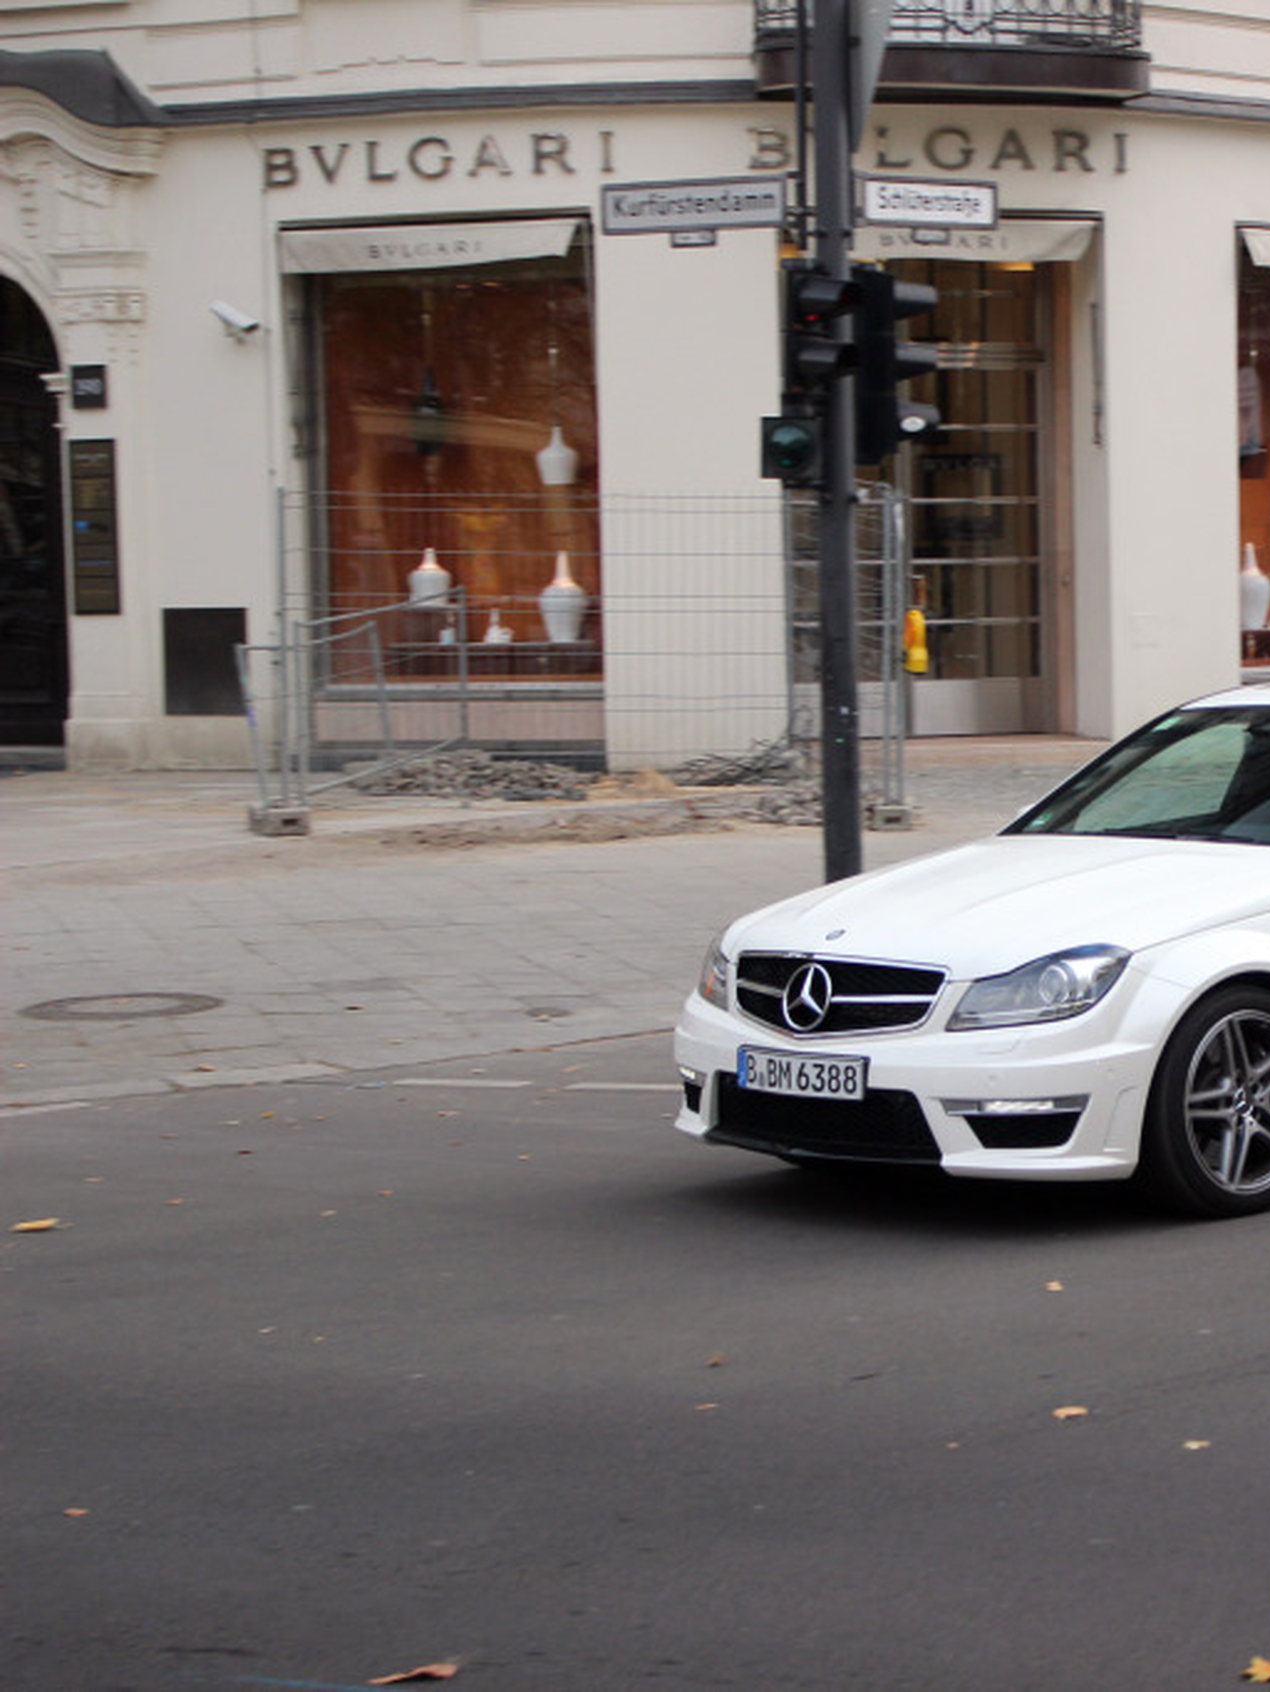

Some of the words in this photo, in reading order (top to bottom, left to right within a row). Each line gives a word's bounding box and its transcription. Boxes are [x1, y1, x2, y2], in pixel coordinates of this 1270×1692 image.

[263, 130, 616, 187] BVLGARI
[748, 126, 1130, 174] BLGARI
[611, 188, 776, 218] Kurfürstendamm
[875, 186, 981, 217] Schlüterstraße
[367, 240, 482, 259] BVLGARI
[878, 233, 1009, 250] BVARI
[746, 1054, 757, 1083] B
[767, 1059, 792, 1089] BM
[796, 1063, 857, 1094] 6388
